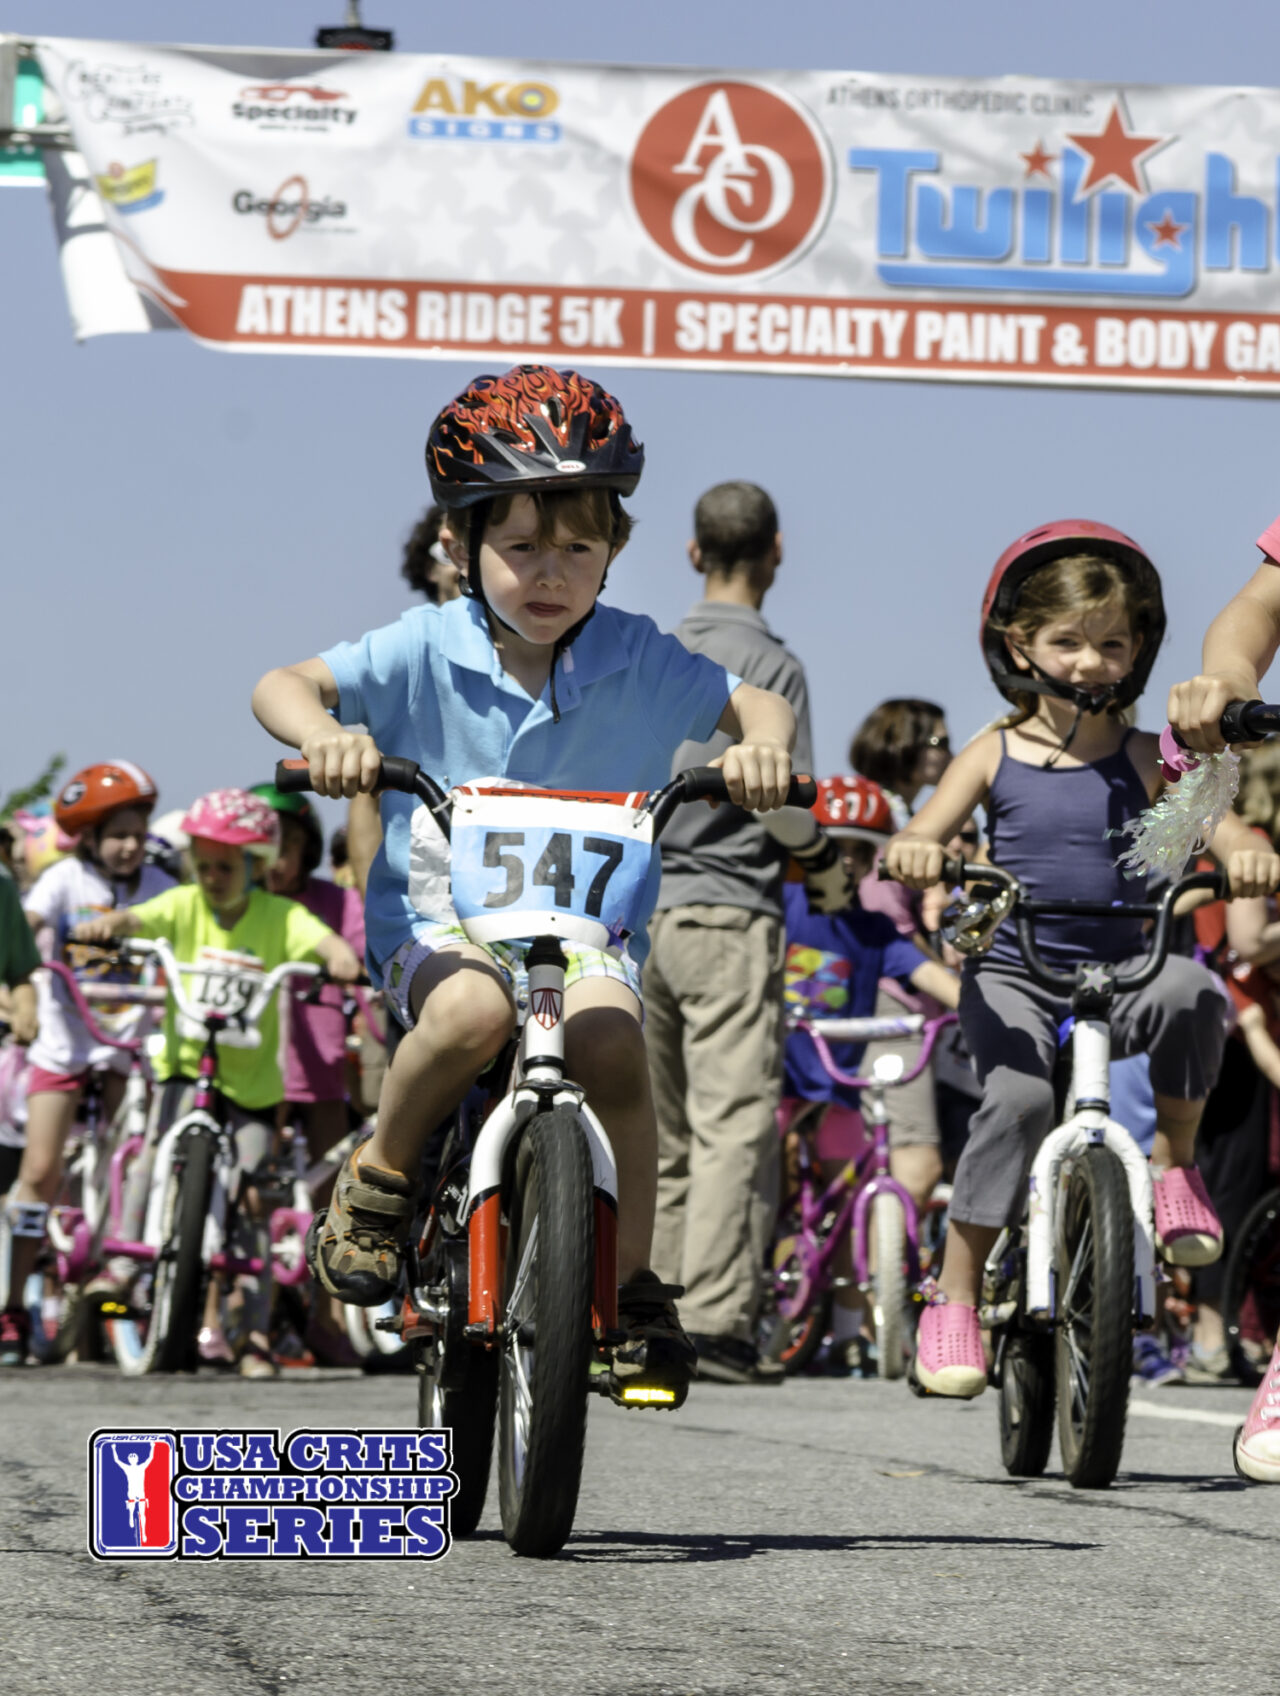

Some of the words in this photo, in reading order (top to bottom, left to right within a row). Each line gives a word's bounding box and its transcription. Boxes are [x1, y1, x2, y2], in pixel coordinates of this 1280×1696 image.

[232, 103, 357, 125] Specialty
[412, 78, 560, 119] AKO
[827, 86, 899, 110] ATHENS
[416, 121, 556, 139] SIGNS
[236, 284, 408, 340] ATHENS
[416, 291, 552, 345] RIDGE
[559, 297, 624, 347] 5K
[674, 301, 908, 358] SPECIALTY
[914, 311, 1046, 363] PAINT
[1052, 323, 1089, 366] &
[1095, 318, 1218, 370] BODY
[482, 832, 624, 918] 547
